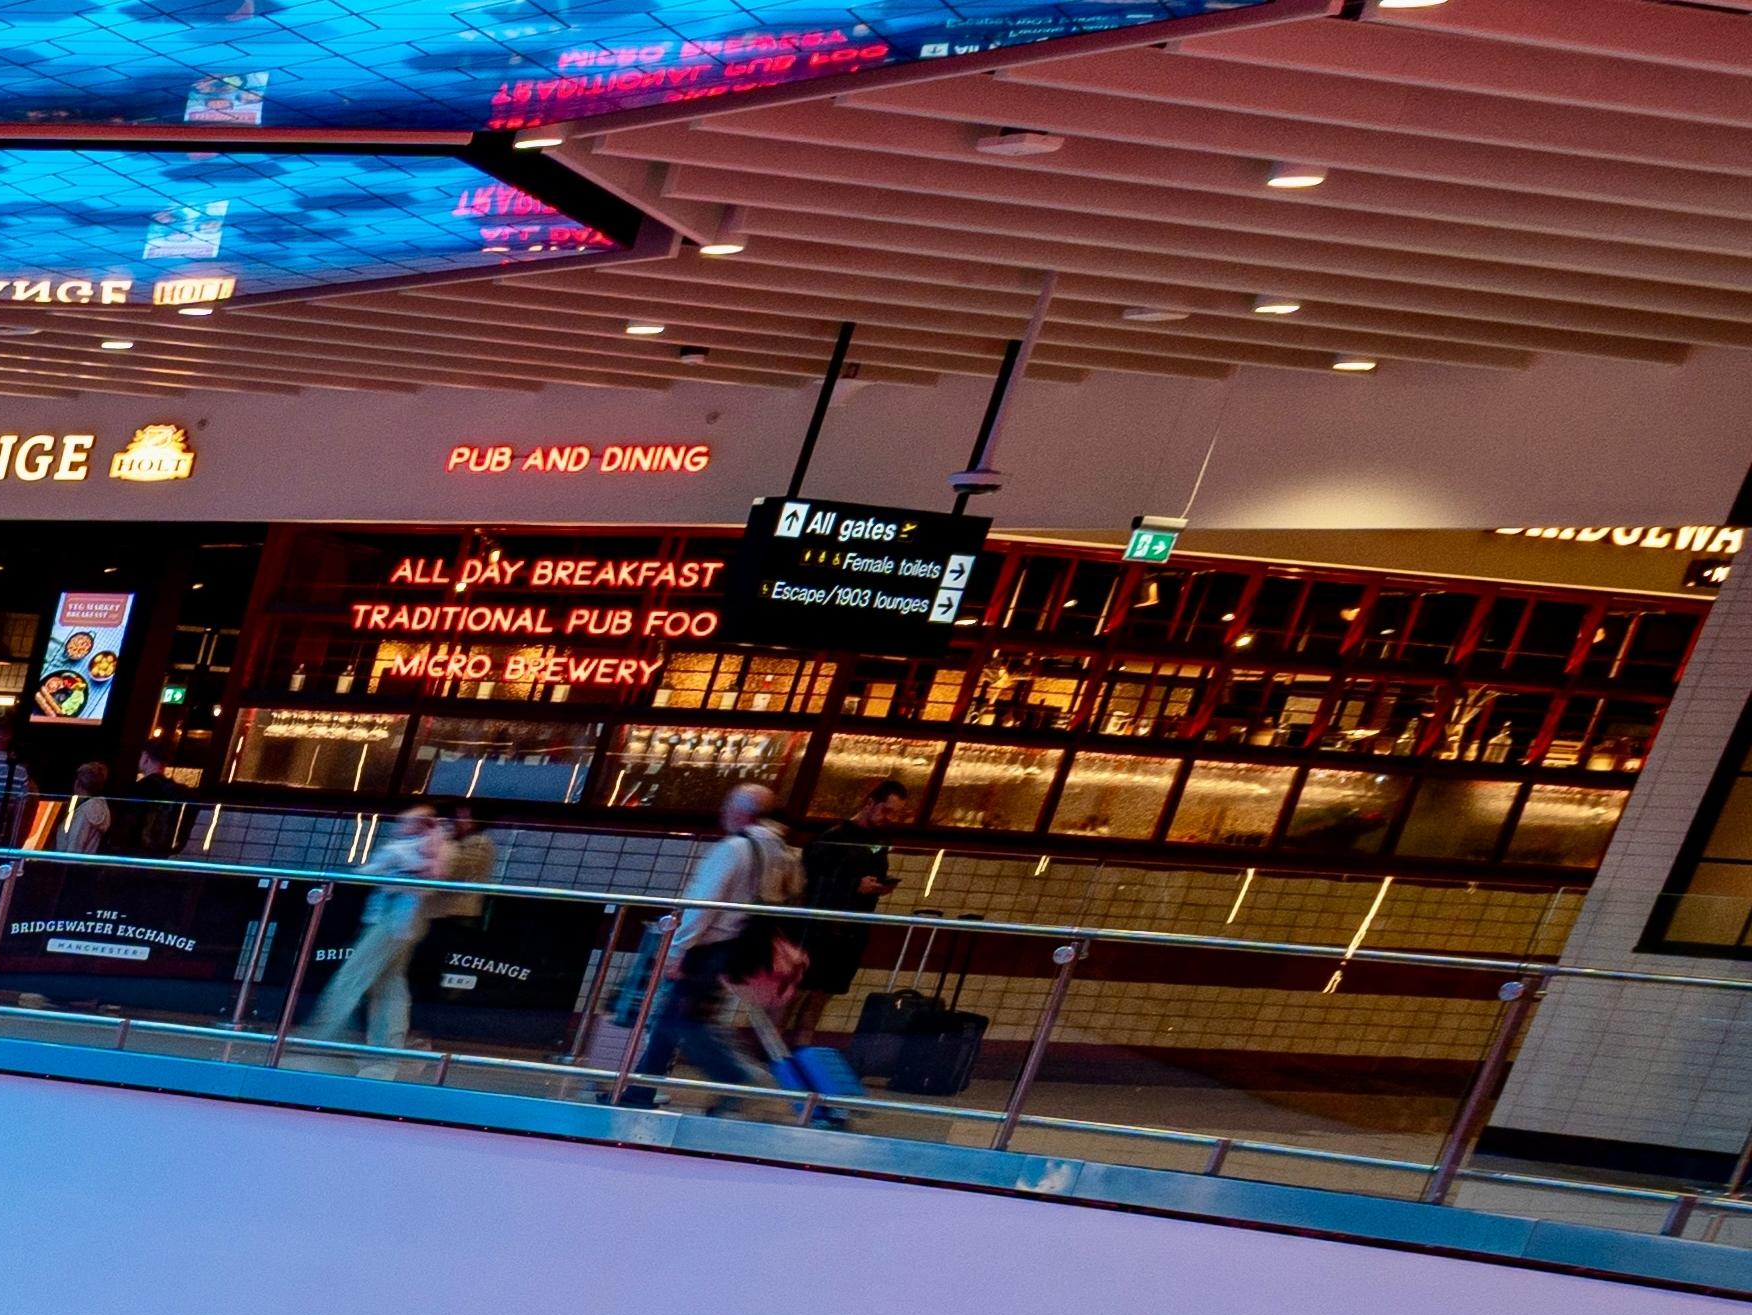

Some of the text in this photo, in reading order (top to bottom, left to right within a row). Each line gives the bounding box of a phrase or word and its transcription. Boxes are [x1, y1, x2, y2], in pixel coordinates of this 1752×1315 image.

[112, 456, 192, 479] HOLT
[448, 445, 710, 473] PUB AND DINING
[806, 511, 897, 541] All gates
[391, 558, 725, 588] ALL DAY BREAKFAST
[842, 552, 942, 579] Female toilets
[771, 581, 930, 615] Escape/1903 lounges
[352, 604, 555, 634] TRADITIONAL
[565, 609, 633, 636] PUB
[390, 654, 663, 685] MICRO BREWERY
[96, 909, 118, 920] THE
[10, 920, 197, 953] BRIDGEWATER EXCHANGE
[448, 953, 532, 981] XCHANGE
